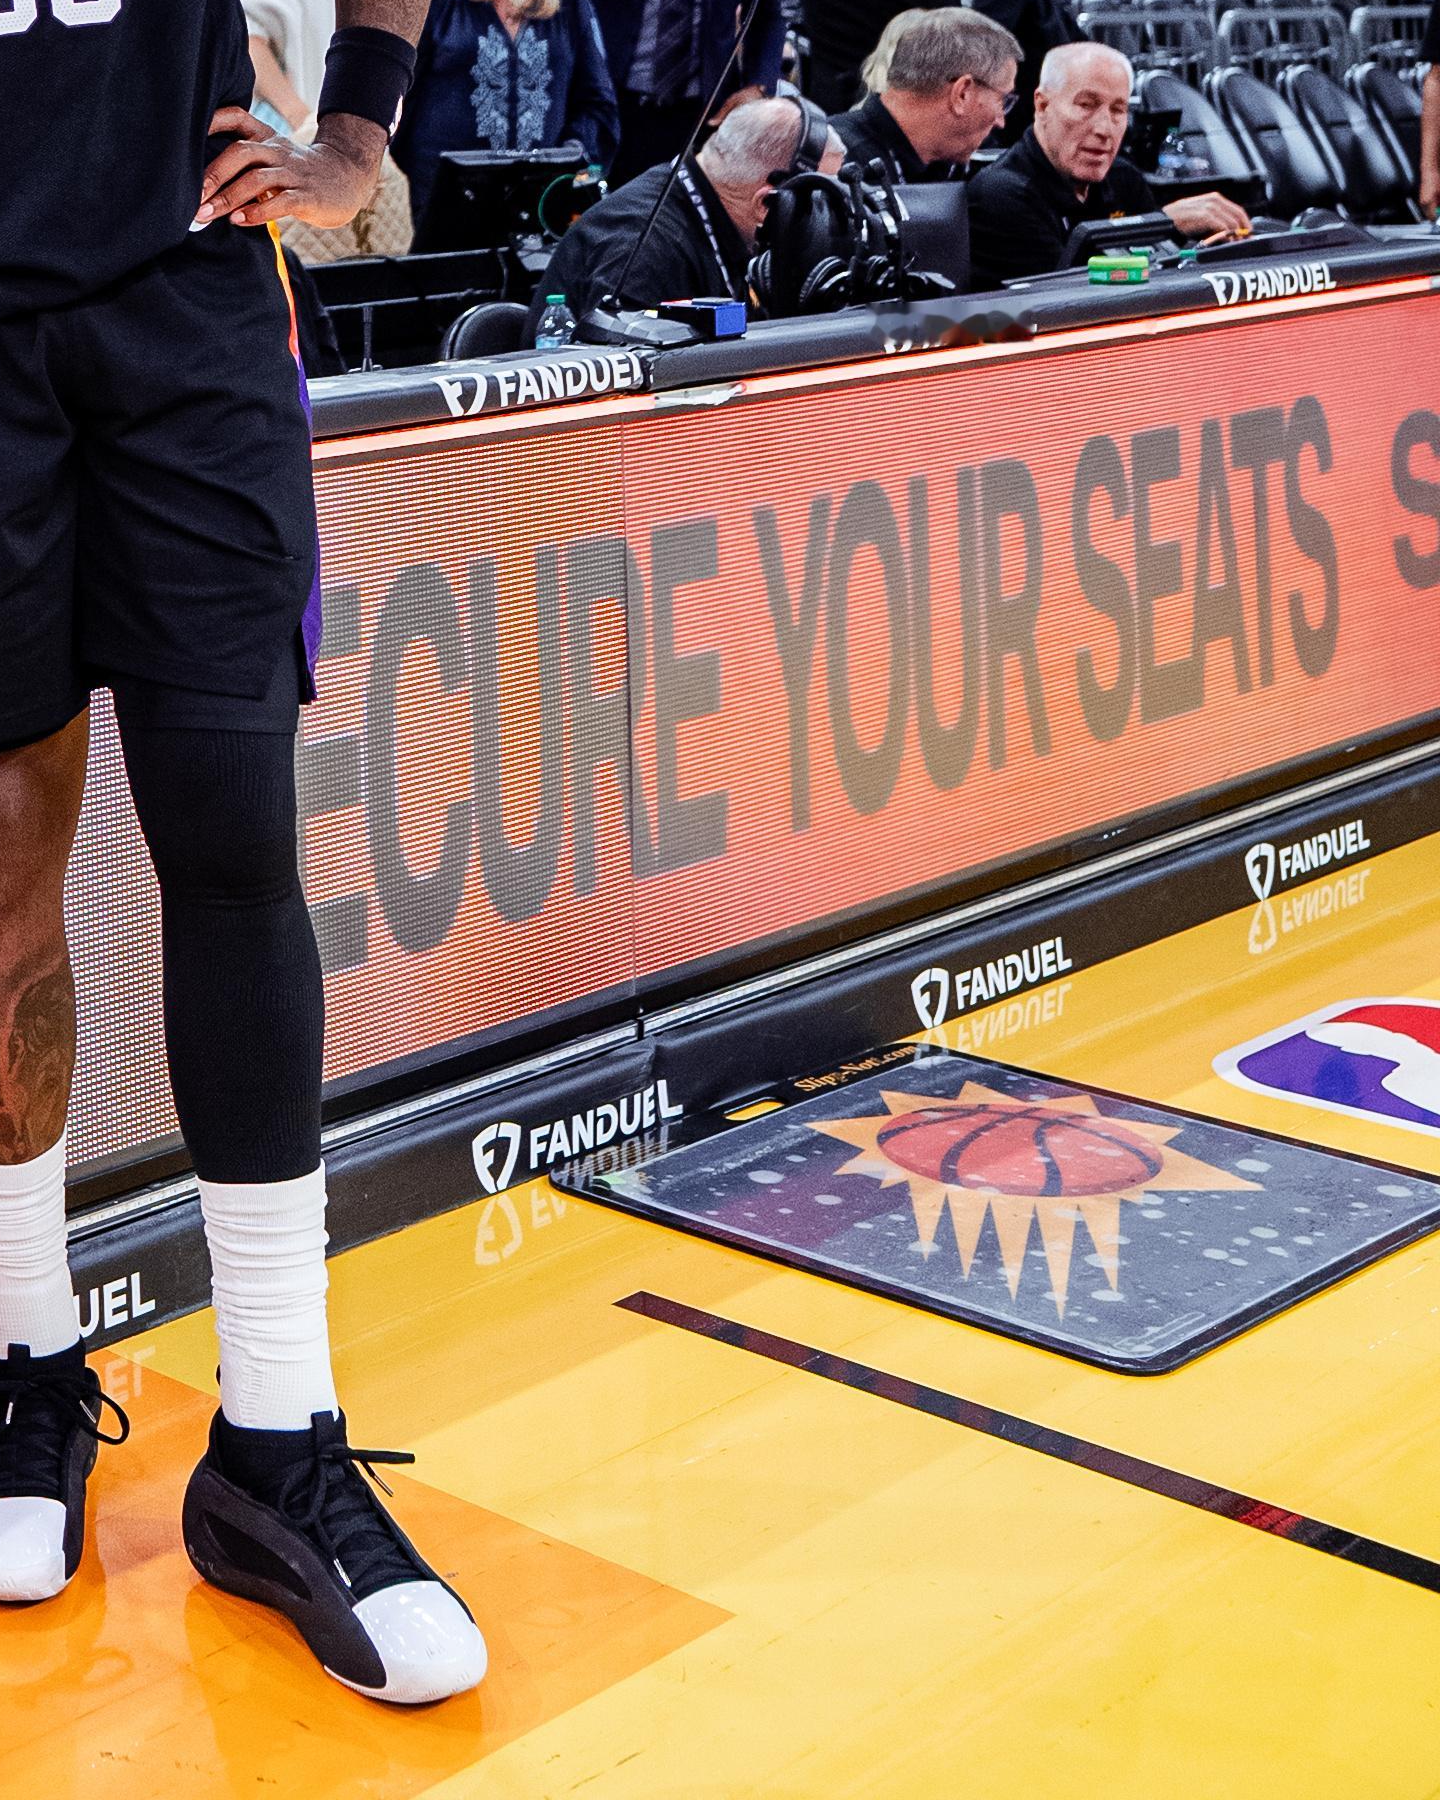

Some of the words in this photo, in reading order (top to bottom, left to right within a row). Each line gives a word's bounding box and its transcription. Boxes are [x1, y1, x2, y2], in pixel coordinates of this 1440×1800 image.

[1241, 262, 1338, 301] FANDUEL
[295, 516, 731, 972] ECURE
[754, 457, 1052, 834] YOUR
[1071, 395, 1339, 742] SEATS
[1279, 820, 1371, 881] FANDUEL
[955, 936, 1074, 1011] FANDUEL
[529, 1079, 684, 1170] FANDUEL
